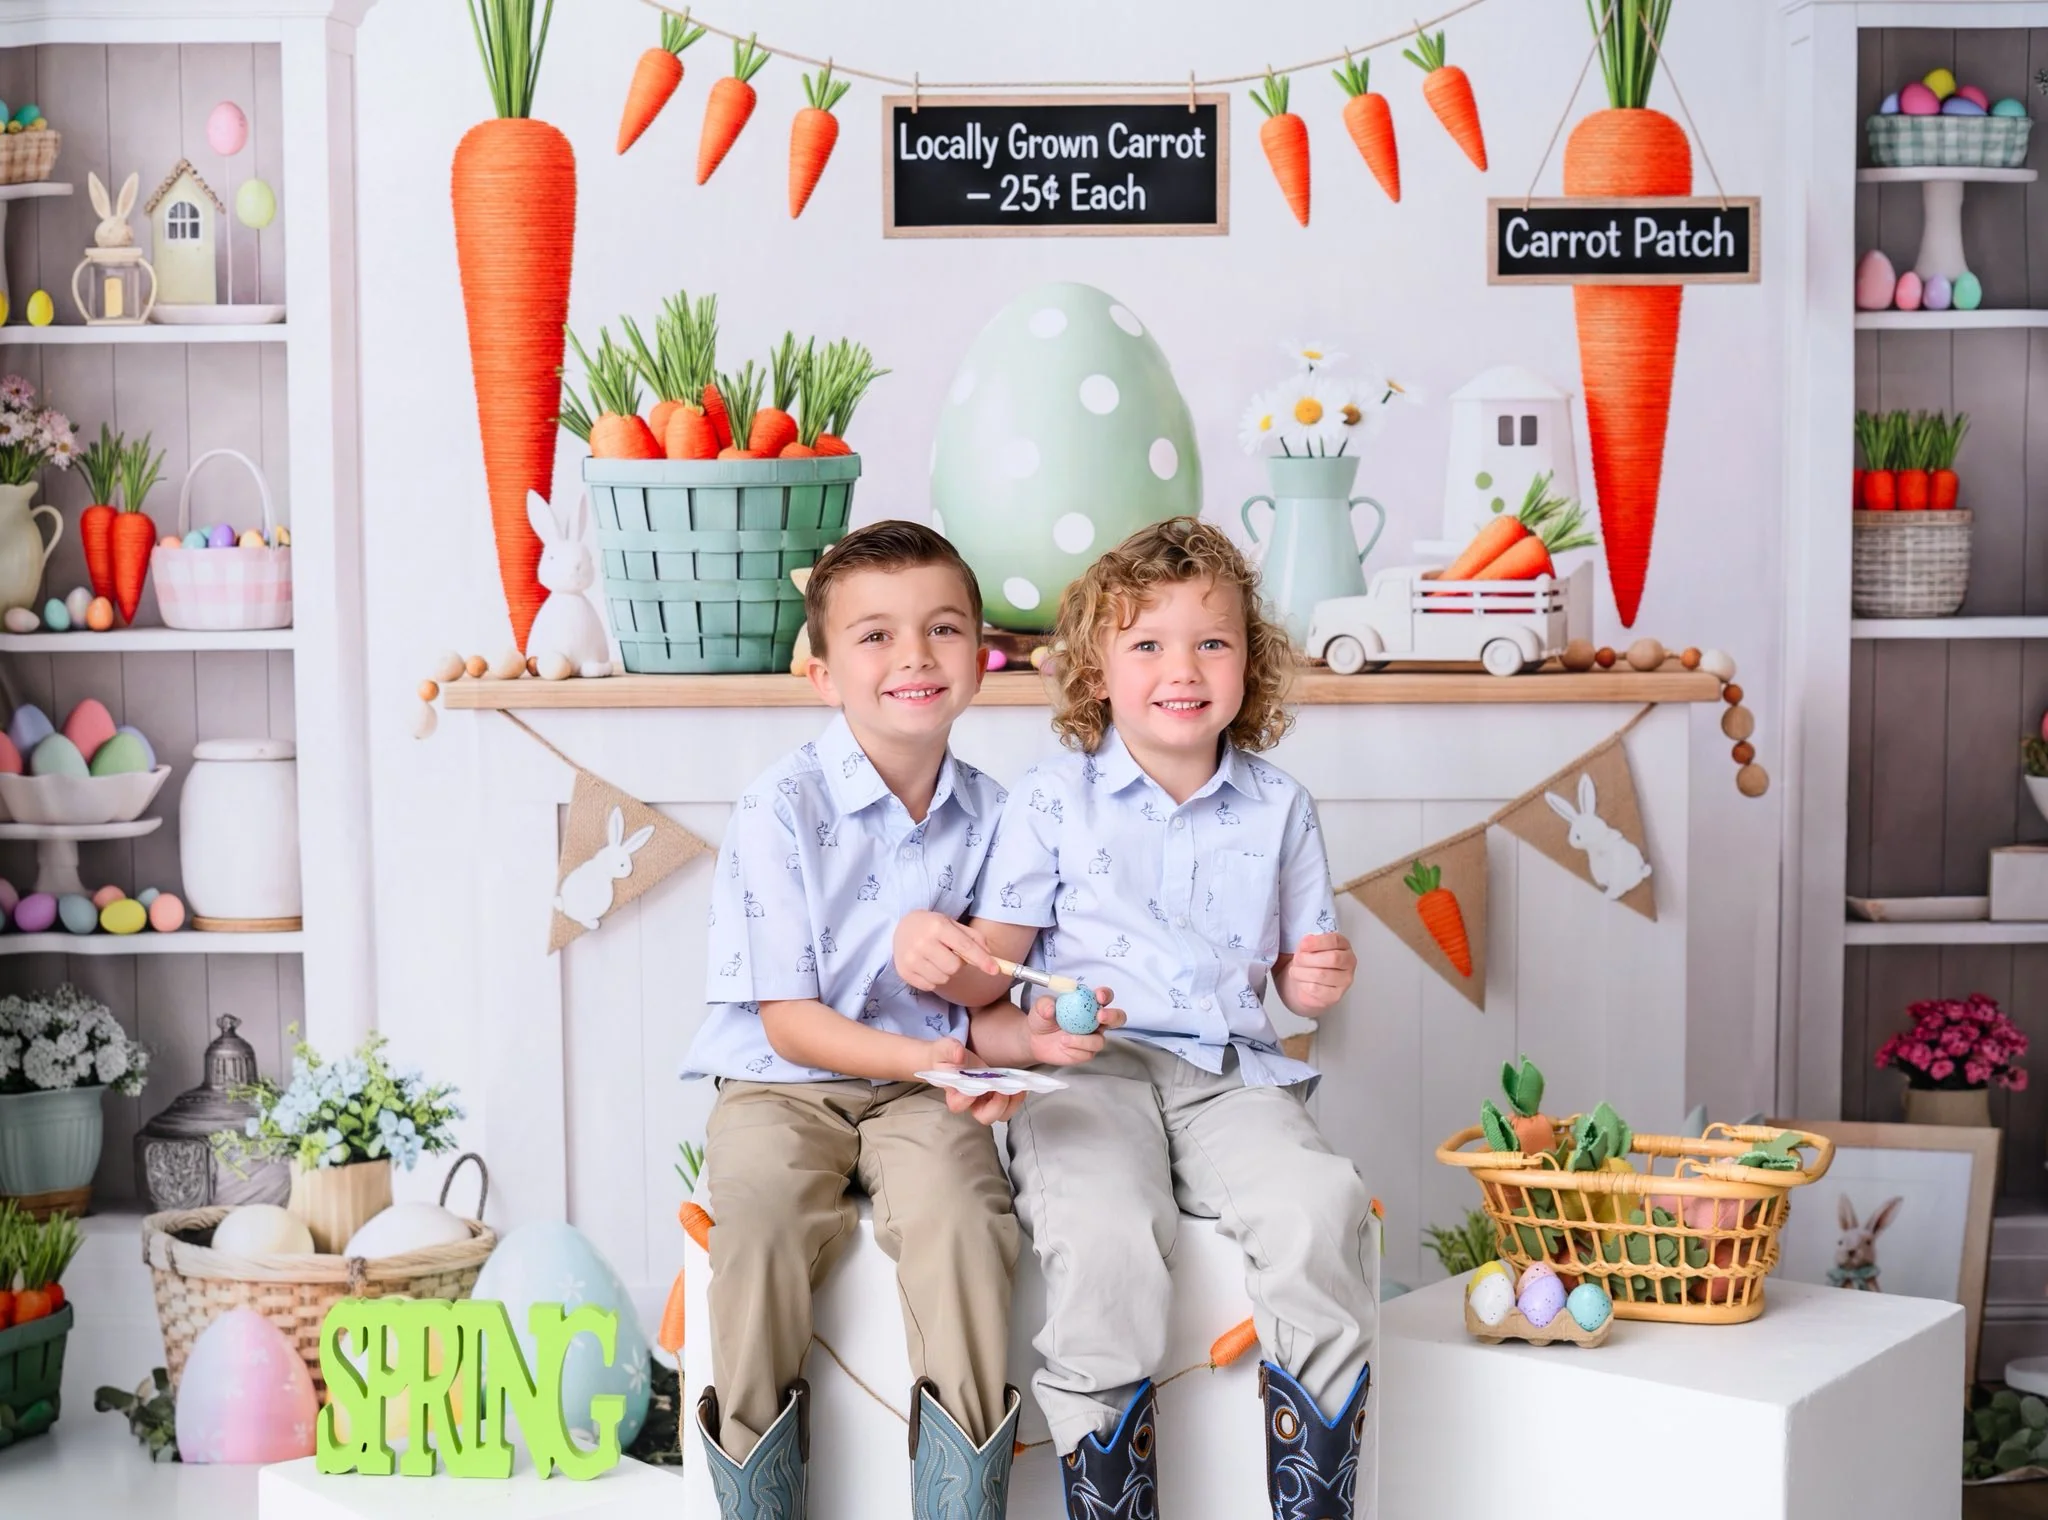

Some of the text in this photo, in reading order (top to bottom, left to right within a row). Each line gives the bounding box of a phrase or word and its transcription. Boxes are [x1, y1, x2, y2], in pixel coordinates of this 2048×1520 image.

[900, 121, 1206, 169] Locally Grown Carrot
[999, 173, 1060, 211] 25¢
[1071, 172, 1146, 211] Each
[1505, 216, 1734, 258] Carrot Patch
[316, 1295, 627, 1481] SPRING
